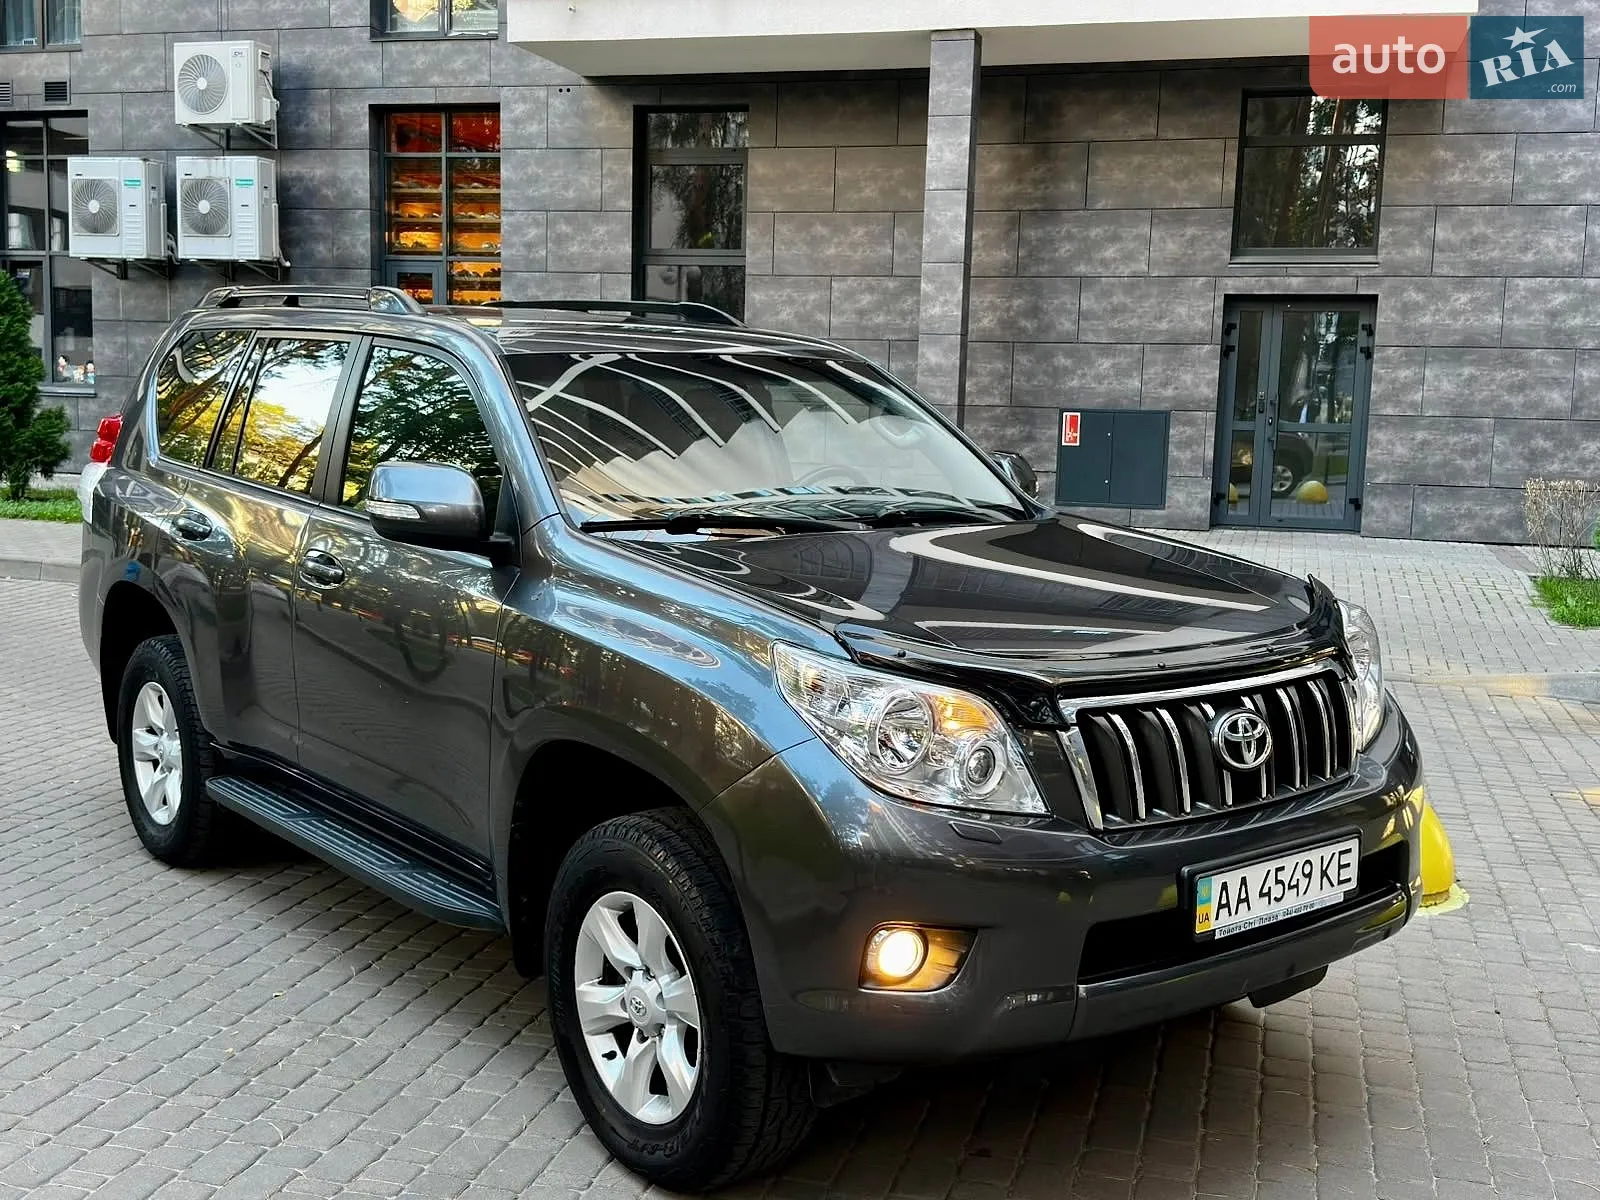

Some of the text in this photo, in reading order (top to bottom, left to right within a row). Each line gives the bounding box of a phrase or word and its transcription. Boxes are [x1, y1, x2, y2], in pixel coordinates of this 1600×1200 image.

[1215, 848, 1353, 921] AA 4549 KE
[1198, 912, 1210, 924] UA
